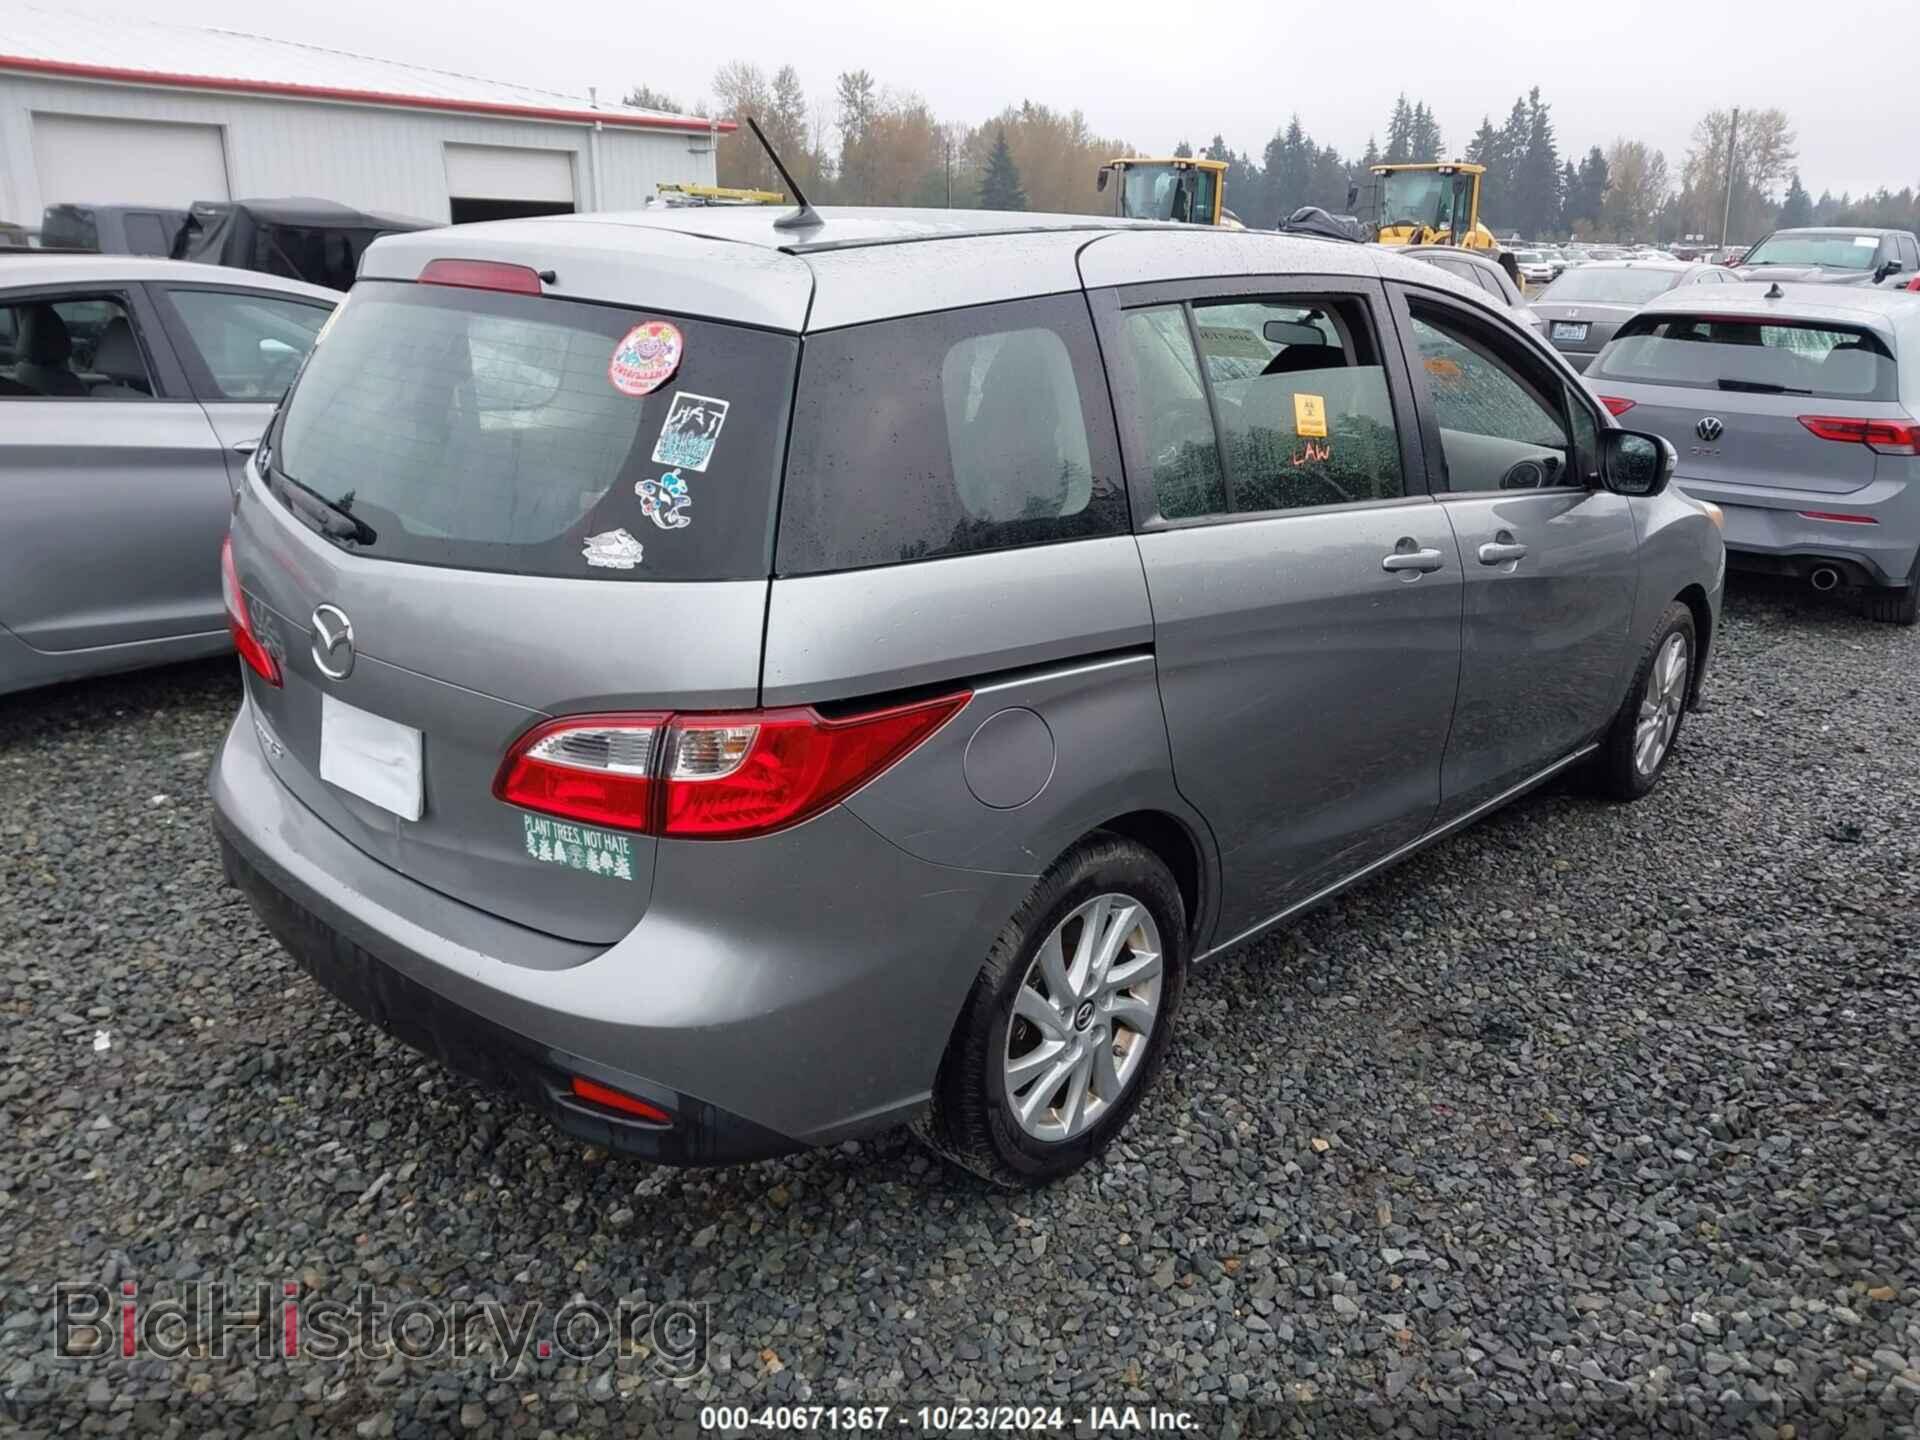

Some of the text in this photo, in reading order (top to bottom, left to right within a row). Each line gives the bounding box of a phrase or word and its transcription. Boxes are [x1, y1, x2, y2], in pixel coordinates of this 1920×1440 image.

[1292, 442, 1330, 465] LAW
[524, 814, 551, 837] PLANT
[583, 829, 602, 849] NOT
[604, 834, 630, 855] HATE
